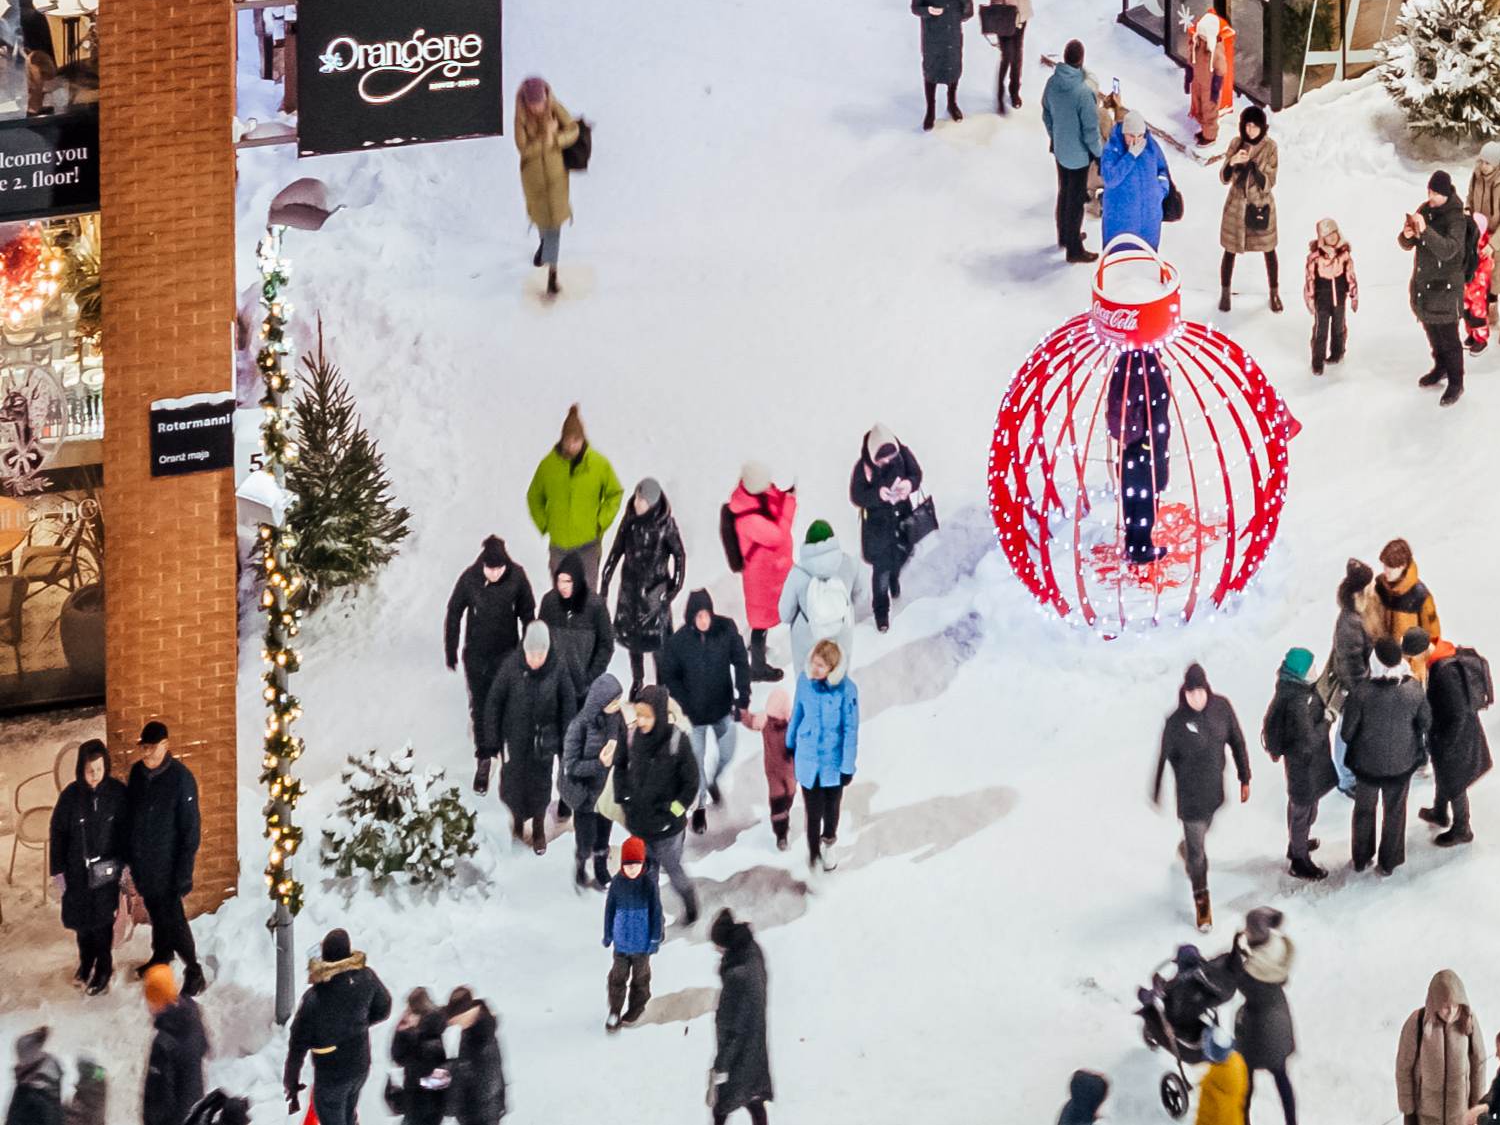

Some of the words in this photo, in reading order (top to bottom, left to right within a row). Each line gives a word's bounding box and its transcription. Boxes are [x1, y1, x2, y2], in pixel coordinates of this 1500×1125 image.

[56, 147, 88, 166] you
[13, 178, 27, 190] 2.
[32, 166, 79, 188] floor!
[158, 413, 231, 433] Rotermanni
[187, 450, 210, 463] maja
